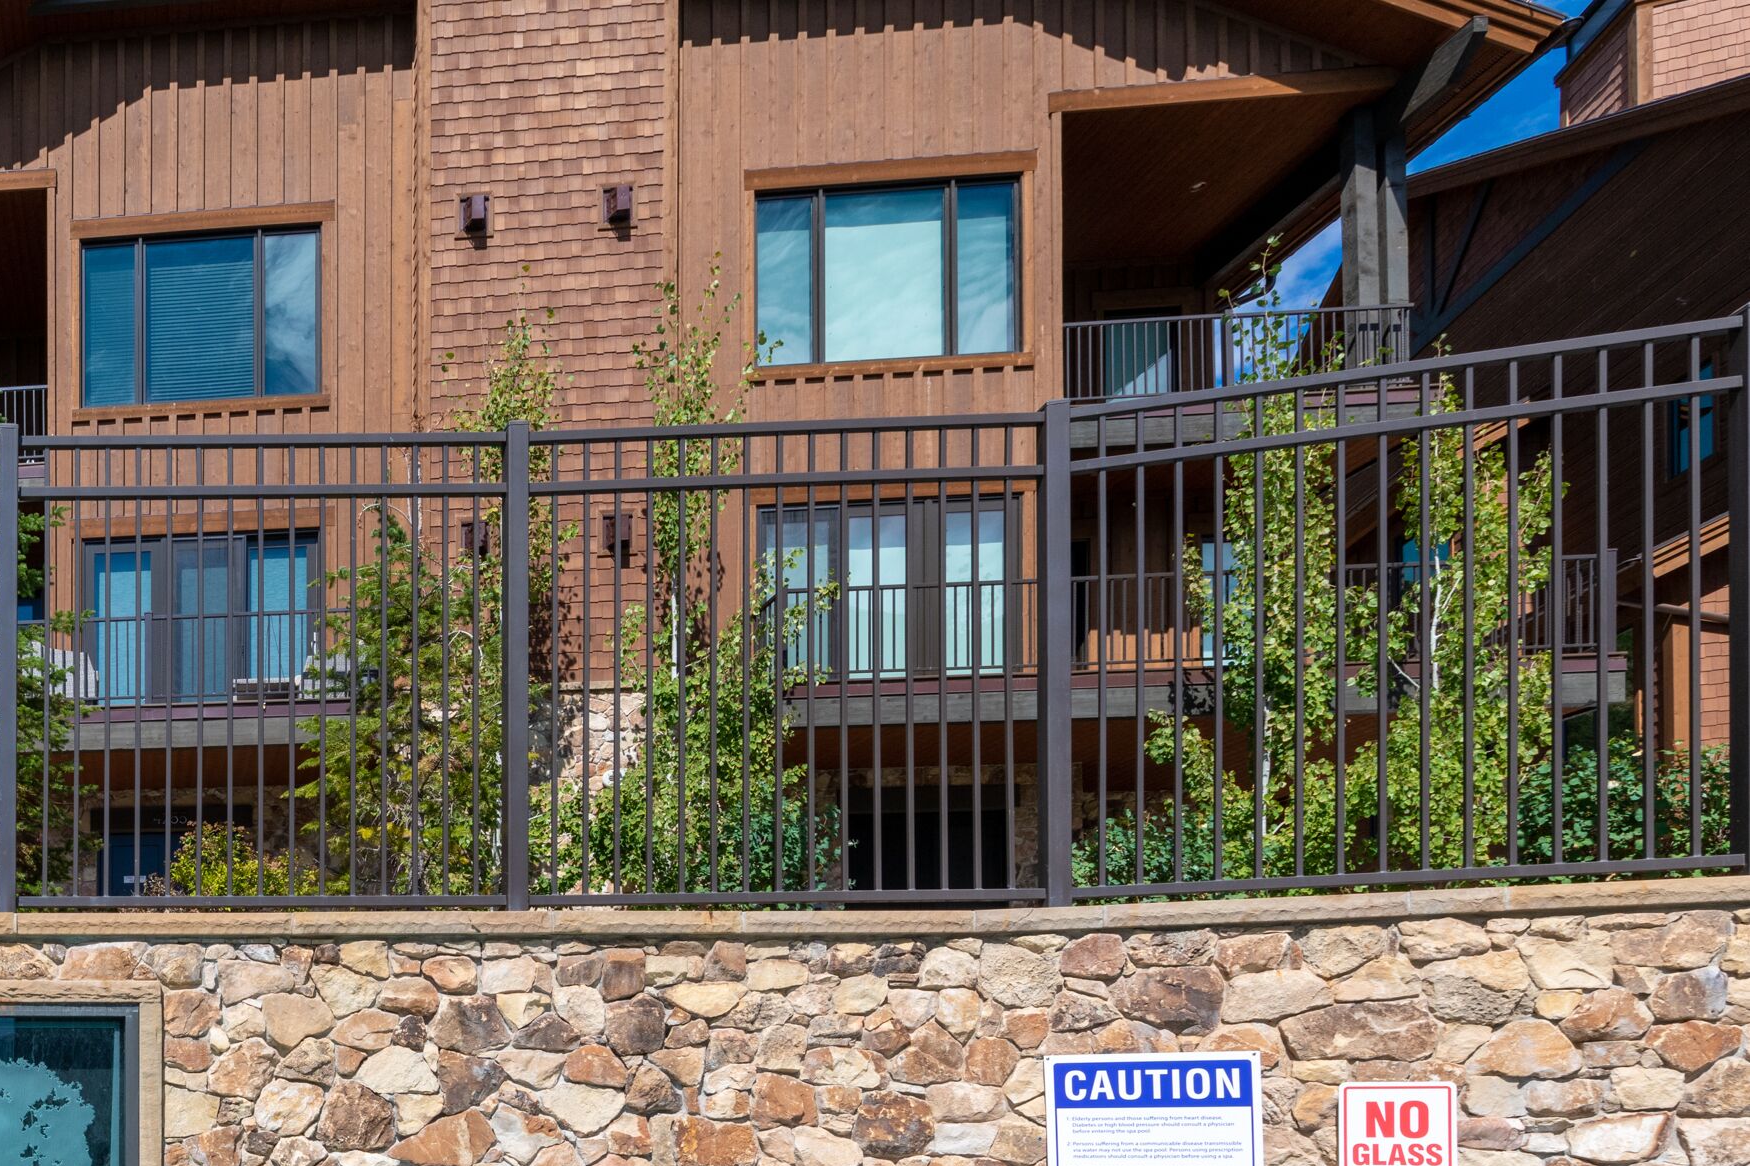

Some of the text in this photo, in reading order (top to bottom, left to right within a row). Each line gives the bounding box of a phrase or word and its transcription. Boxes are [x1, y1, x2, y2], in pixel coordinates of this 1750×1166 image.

[1065, 1068, 1241, 1101] CAUTION
[1366, 1100, 1429, 1138] NO
[1353, 1143, 1443, 1166] GLASS
